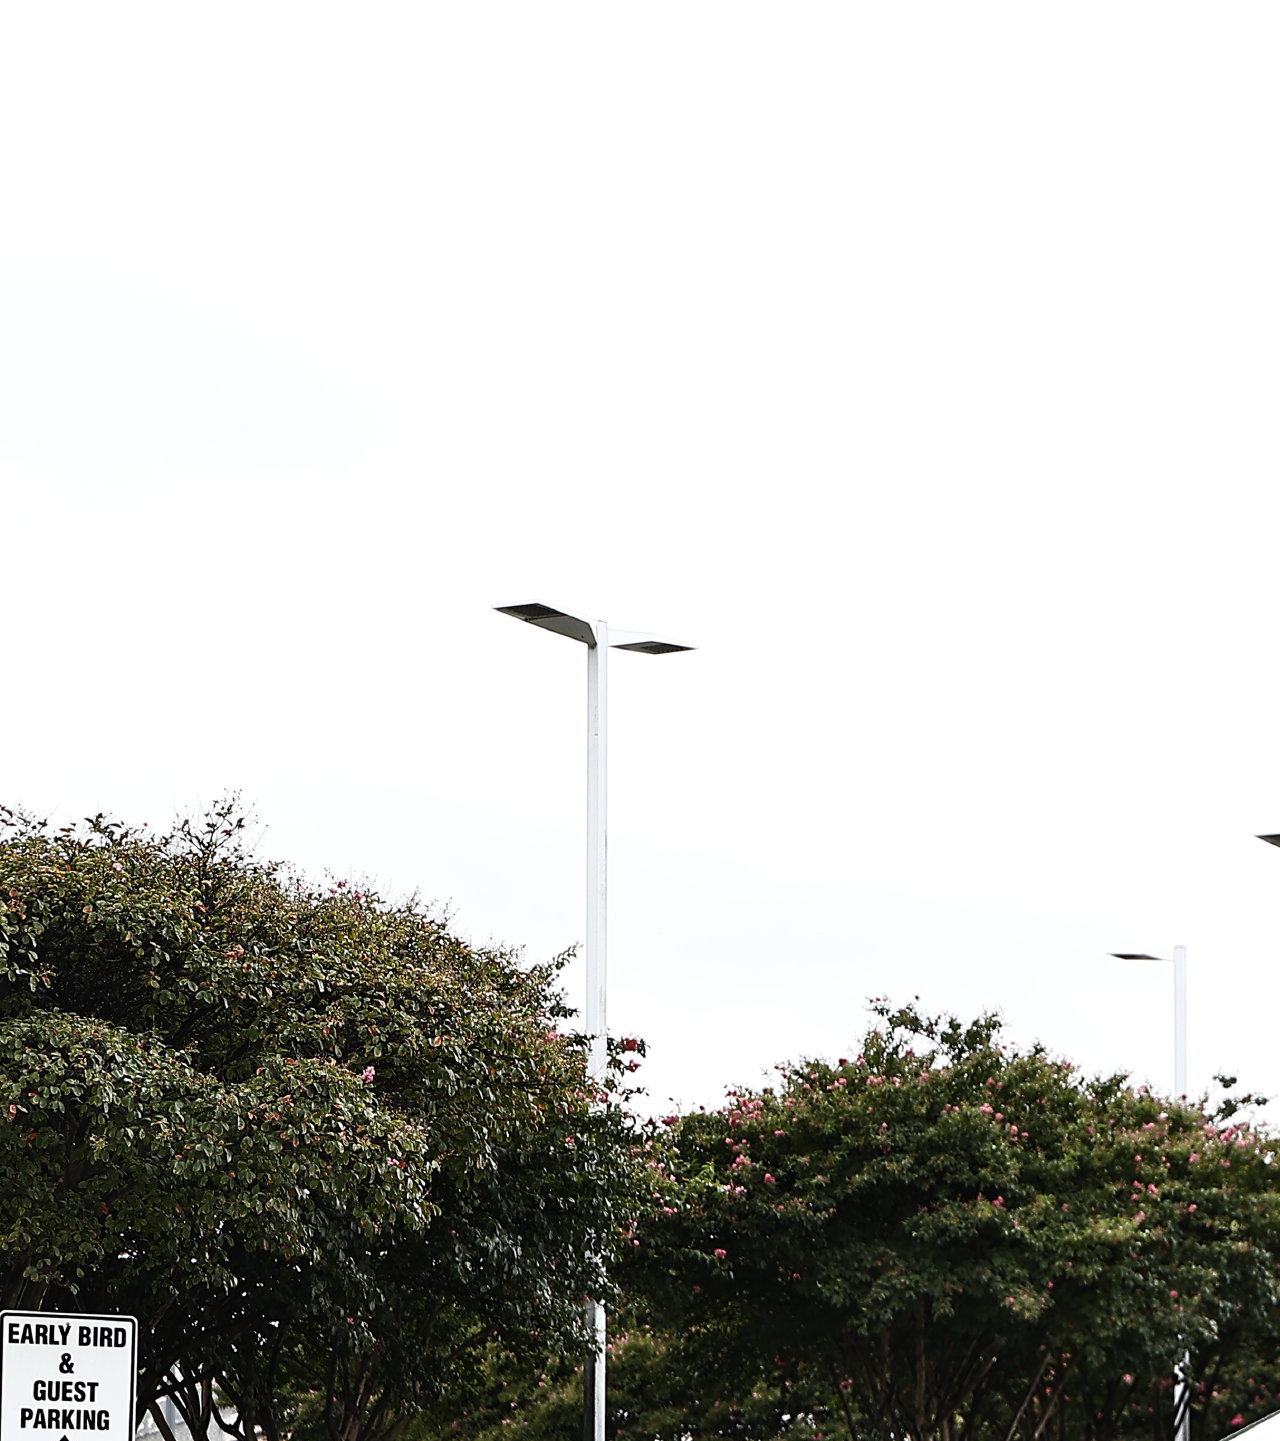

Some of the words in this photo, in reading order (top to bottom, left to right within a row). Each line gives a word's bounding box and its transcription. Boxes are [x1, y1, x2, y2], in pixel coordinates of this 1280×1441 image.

[8, 1323, 71, 1345] EARLY
[78, 1326, 127, 1348] BIRD
[59, 1353, 74, 1374] &
[33, 1380, 99, 1403] GUEST
[20, 1408, 110, 1430] PARKING
